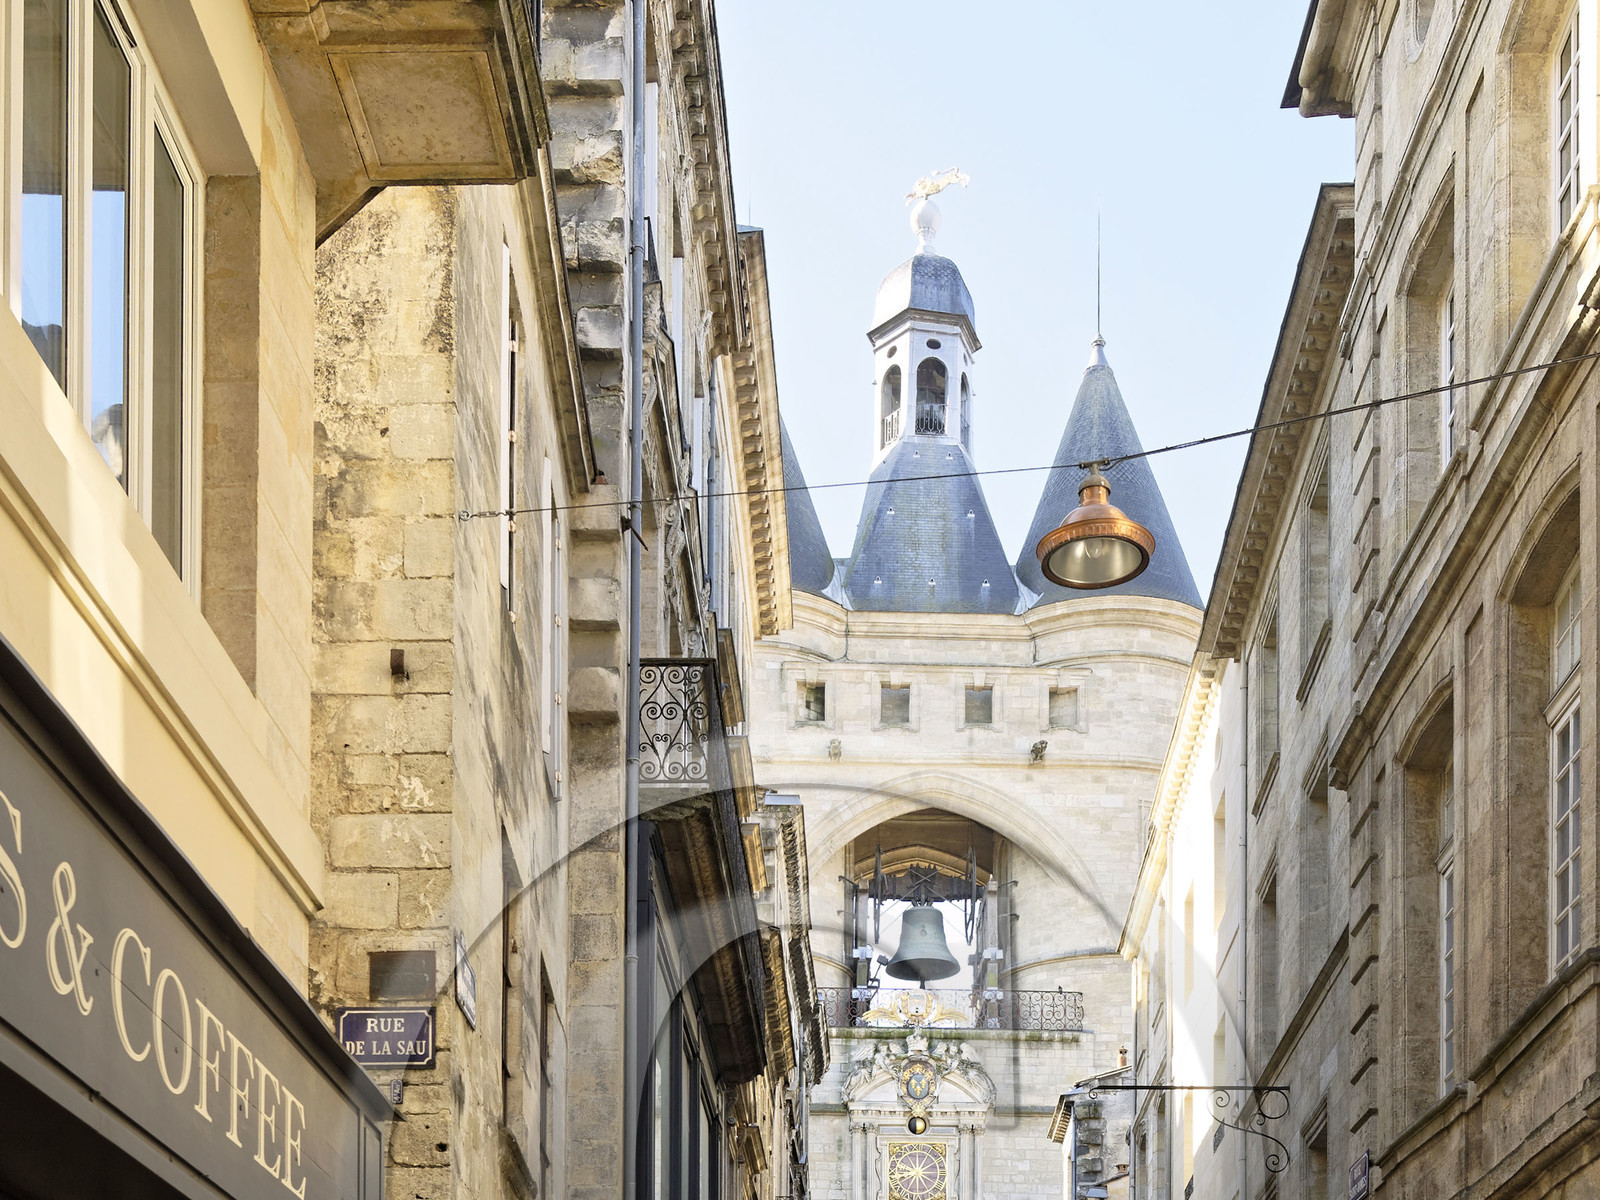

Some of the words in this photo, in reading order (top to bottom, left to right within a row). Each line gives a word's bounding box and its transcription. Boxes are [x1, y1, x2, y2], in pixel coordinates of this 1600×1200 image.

[46, 861, 94, 1016] &
[111, 928, 307, 1200] COFFEE
[366, 1017, 405, 1033] RUE
[345, 1040, 365, 1055] DE
[372, 1040, 392, 1055] LA
[397, 1040, 426, 1055] SAU
